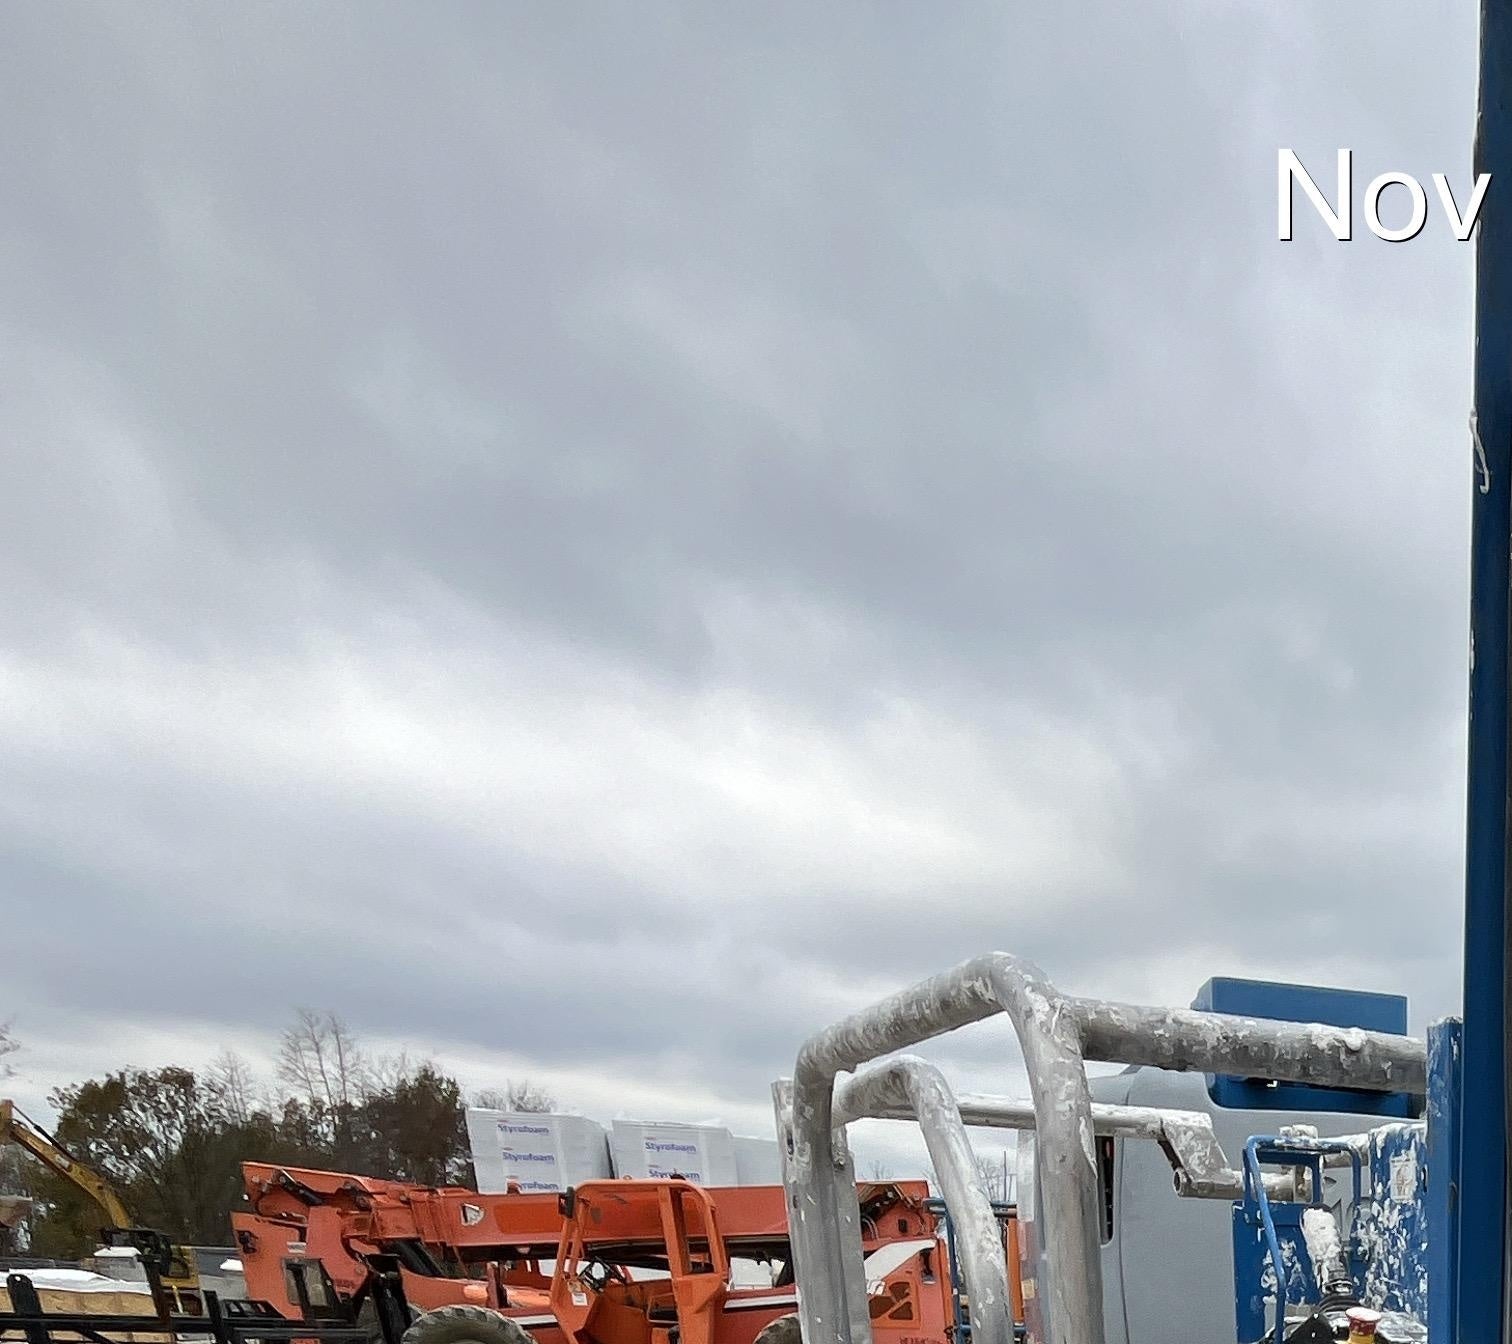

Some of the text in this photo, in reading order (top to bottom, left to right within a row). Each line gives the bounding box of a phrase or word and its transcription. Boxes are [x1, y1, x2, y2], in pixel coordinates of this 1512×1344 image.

[497, 1123, 550, 1135] Styrofoam
[645, 1141, 697, 1153] Styrofoam
[502, 1151, 555, 1163] Styrofoam
